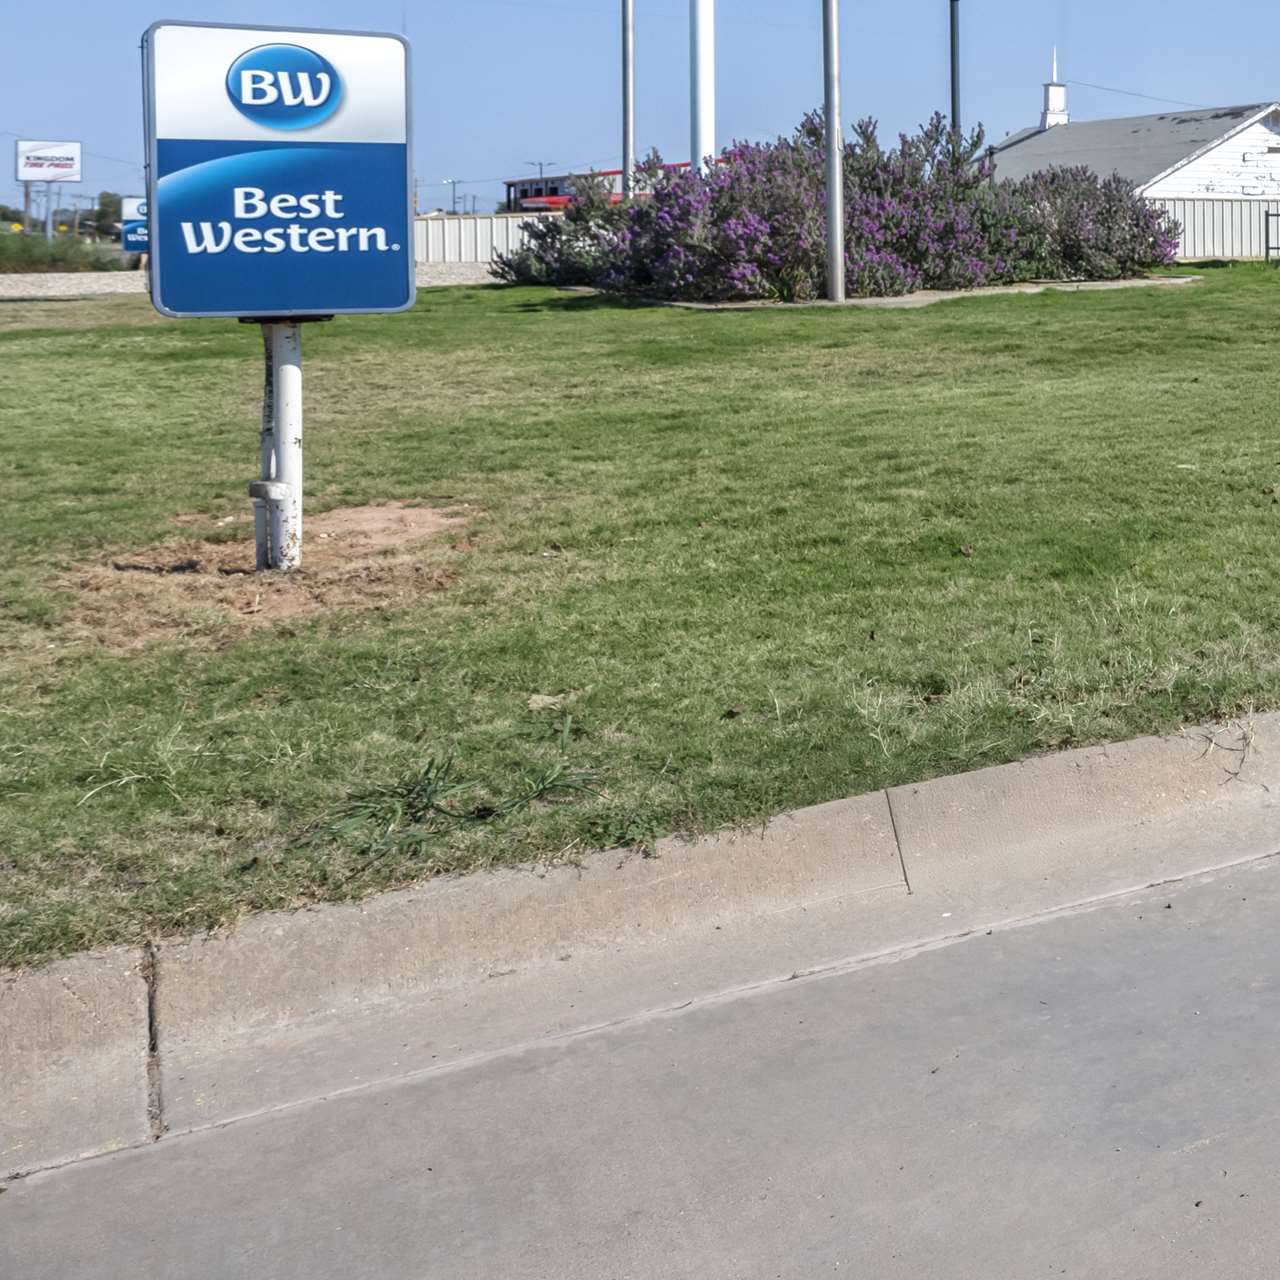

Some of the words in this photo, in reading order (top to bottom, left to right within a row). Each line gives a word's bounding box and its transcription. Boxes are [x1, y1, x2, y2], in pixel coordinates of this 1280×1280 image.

[240, 69, 331, 107] BW
[233, 187, 345, 219] Best
[181, 221, 389, 255] Western
